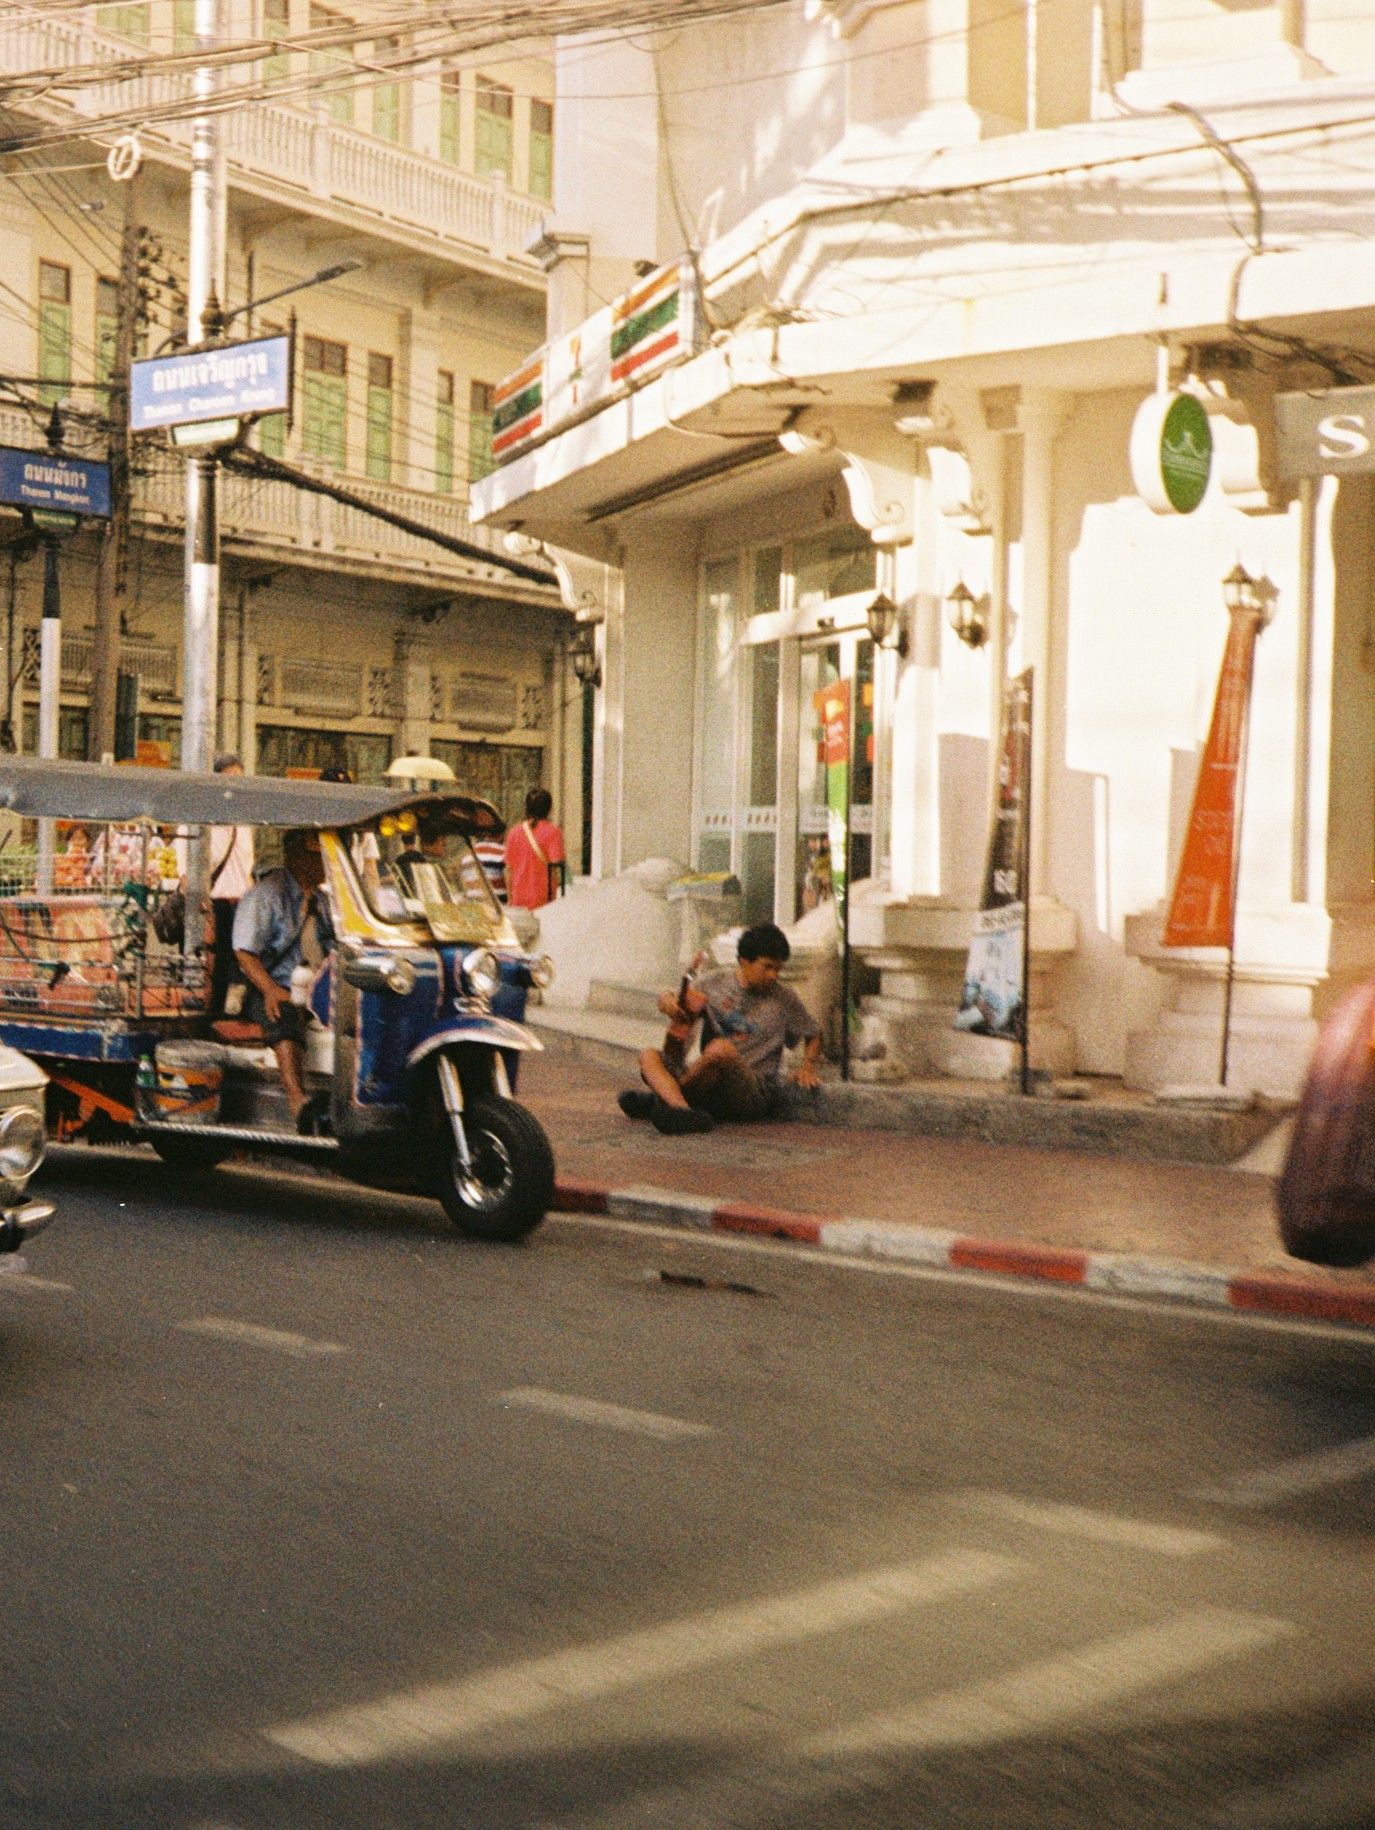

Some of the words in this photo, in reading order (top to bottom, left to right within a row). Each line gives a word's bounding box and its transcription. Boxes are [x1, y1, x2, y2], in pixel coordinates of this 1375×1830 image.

[152, 352, 268, 392] ถนนเจริญกรุง
